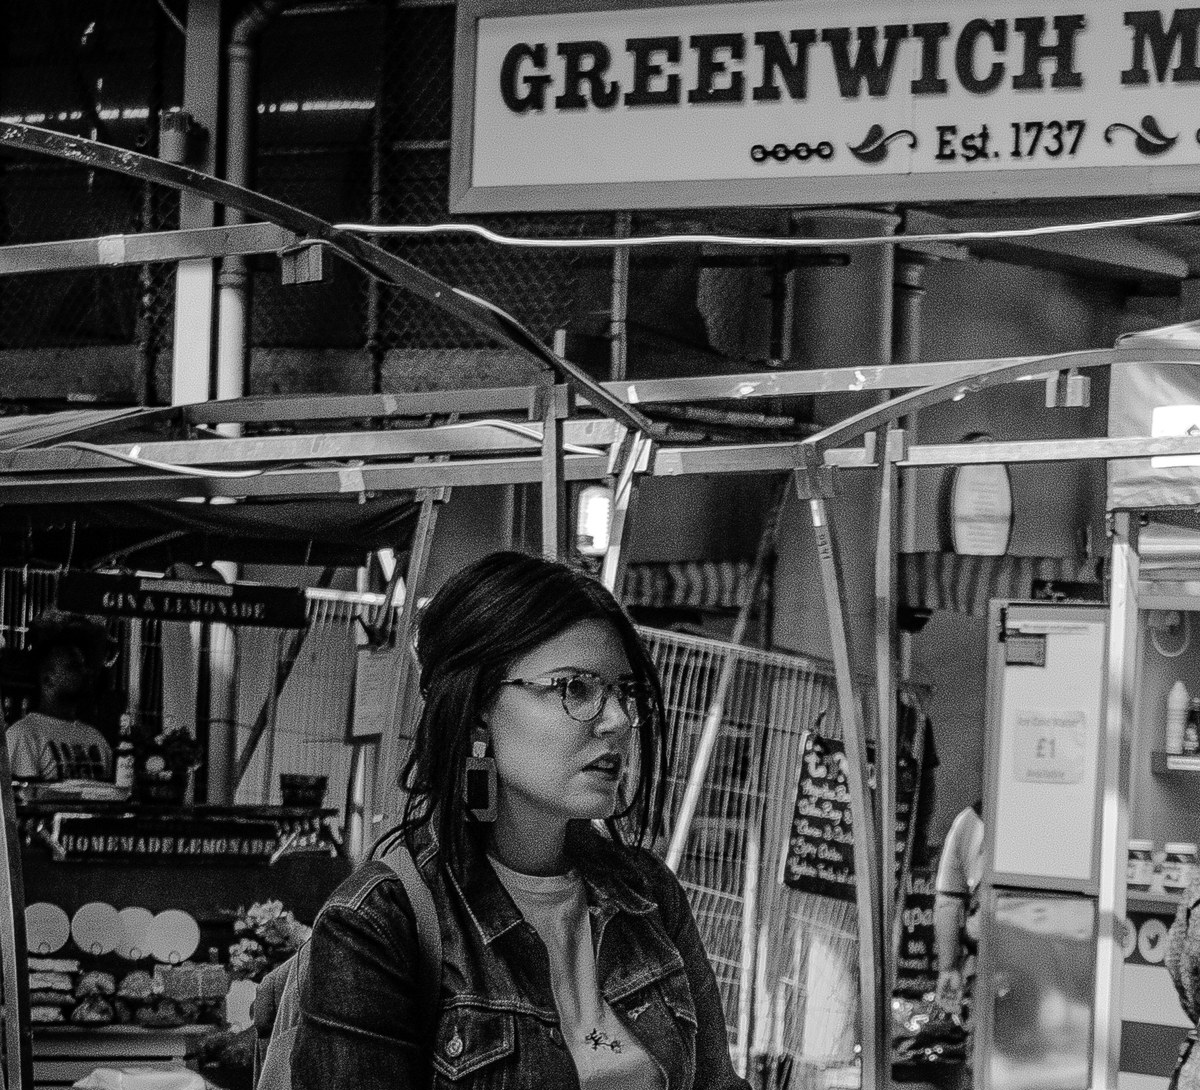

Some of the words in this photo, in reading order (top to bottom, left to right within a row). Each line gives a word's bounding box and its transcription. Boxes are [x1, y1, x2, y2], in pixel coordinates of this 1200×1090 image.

[500, 14, 1086, 114] GREENWICH
[935, 124, 999, 162] Est.
[1010, 119, 1087, 158] 1737
[102, 591, 137, 609] GIN
[163, 597, 266, 620] LEMONADE
[61, 834, 174, 853] HOMEMADE
[176, 836, 276, 856] LEMONADE
